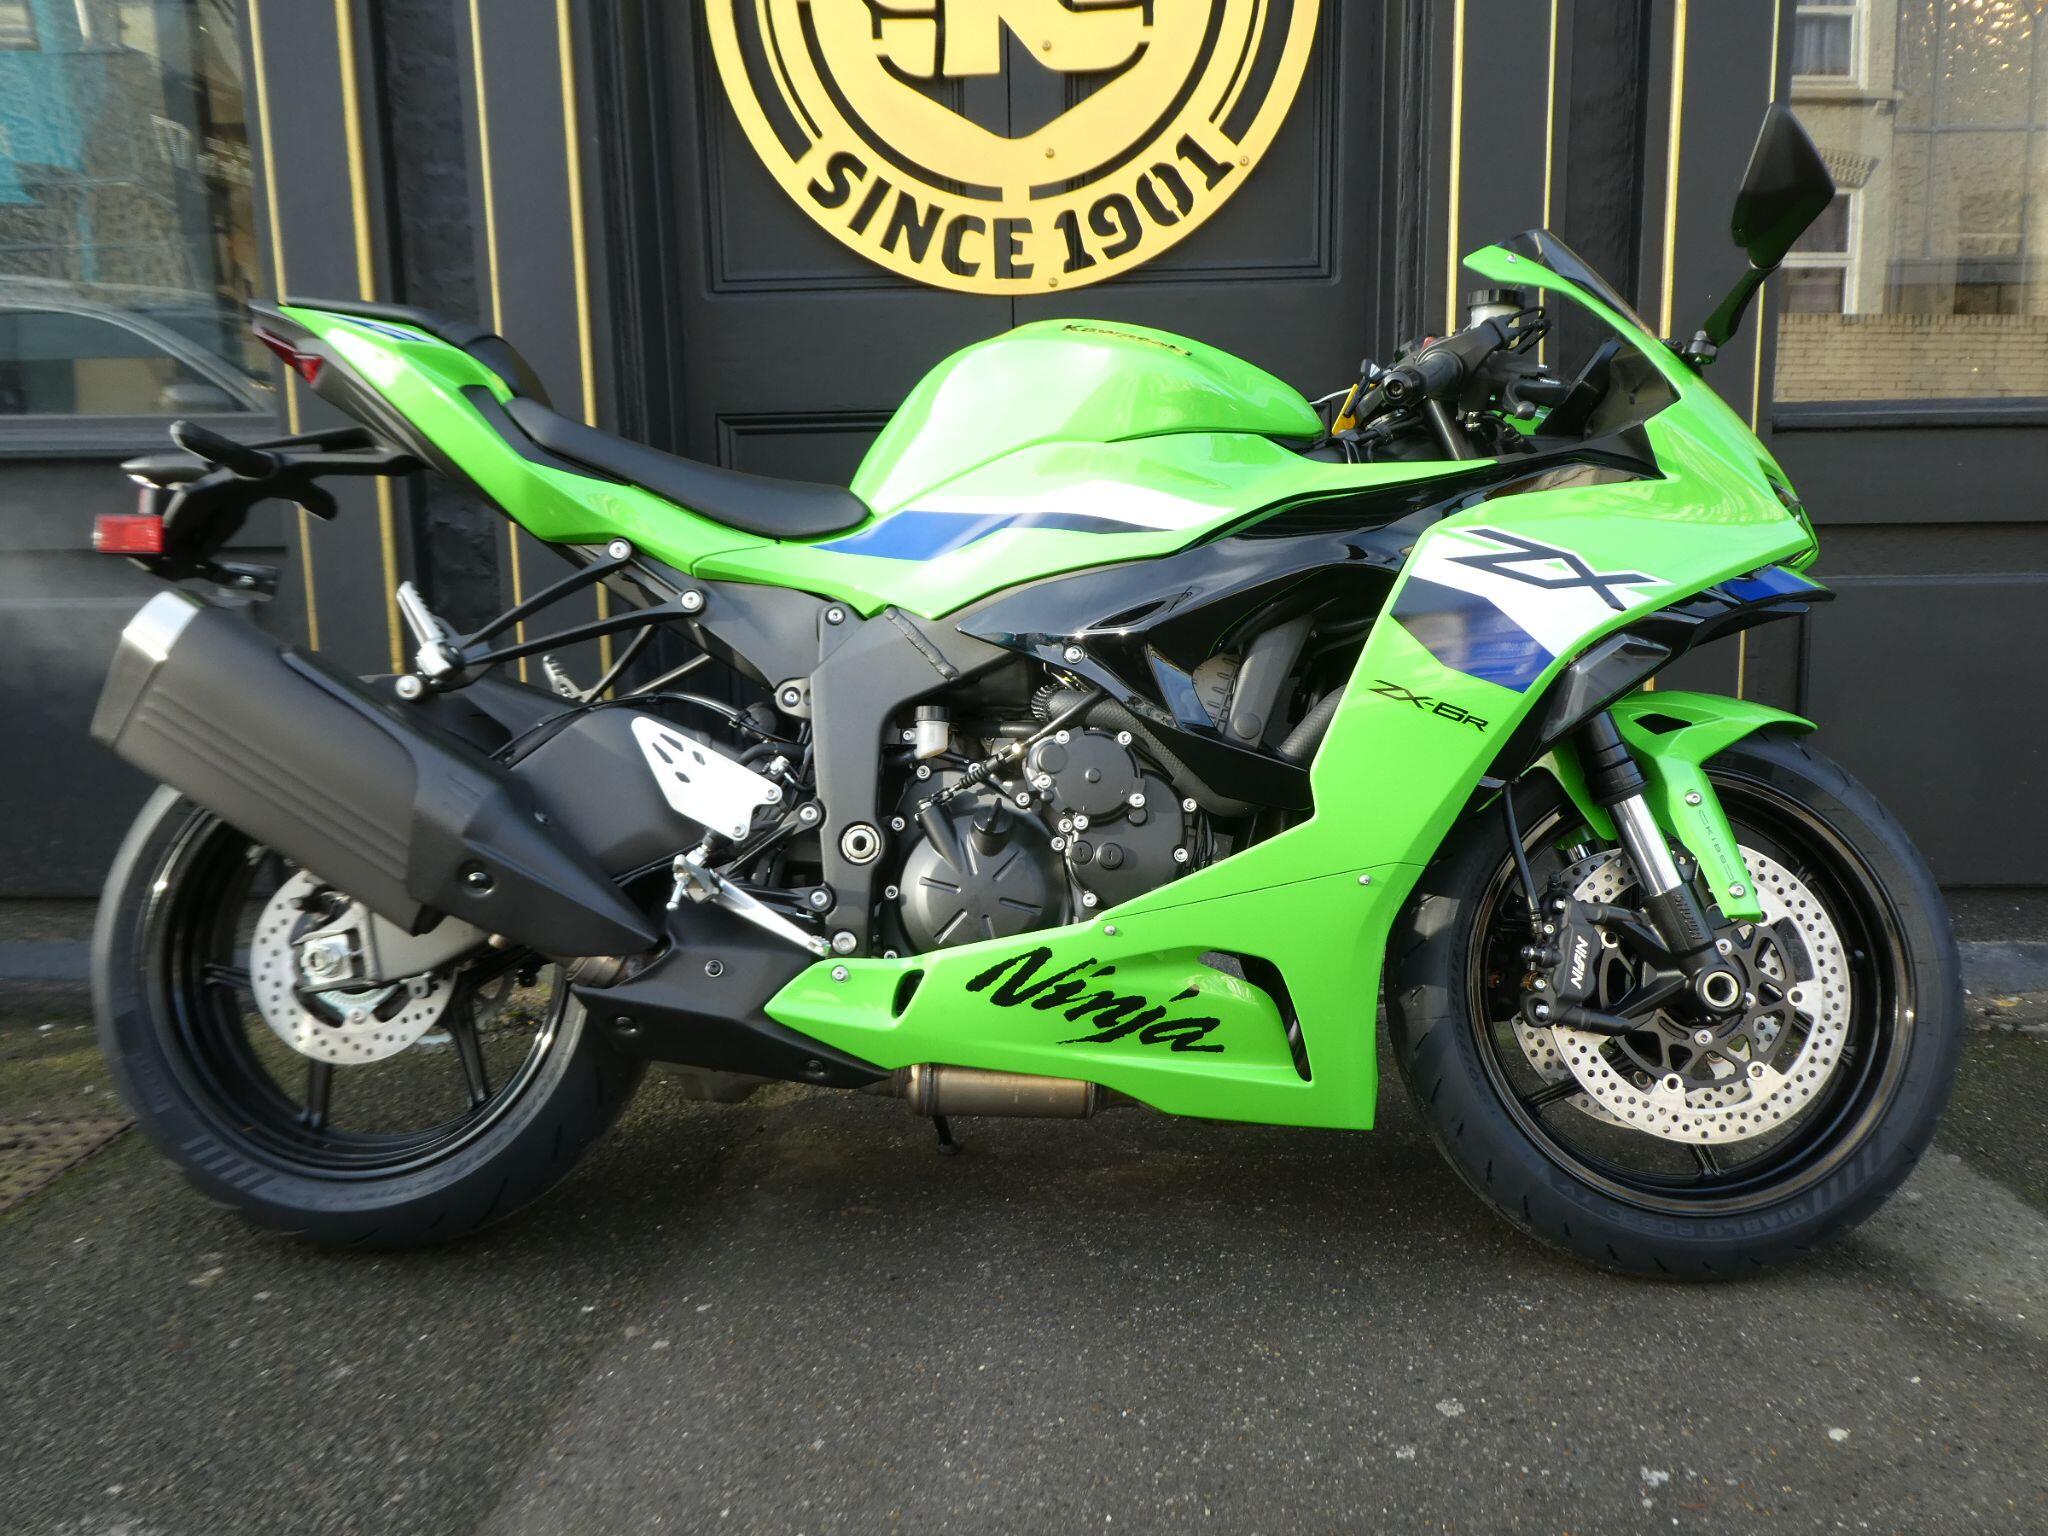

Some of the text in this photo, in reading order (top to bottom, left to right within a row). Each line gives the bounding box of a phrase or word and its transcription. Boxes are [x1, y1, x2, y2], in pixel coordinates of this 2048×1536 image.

[808, 133, 1235, 279] SINCE 1901
[1445, 528, 1658, 611] ZX
[1368, 679, 1489, 732] ZX-6R
[966, 946, 1225, 1052] Ninja
